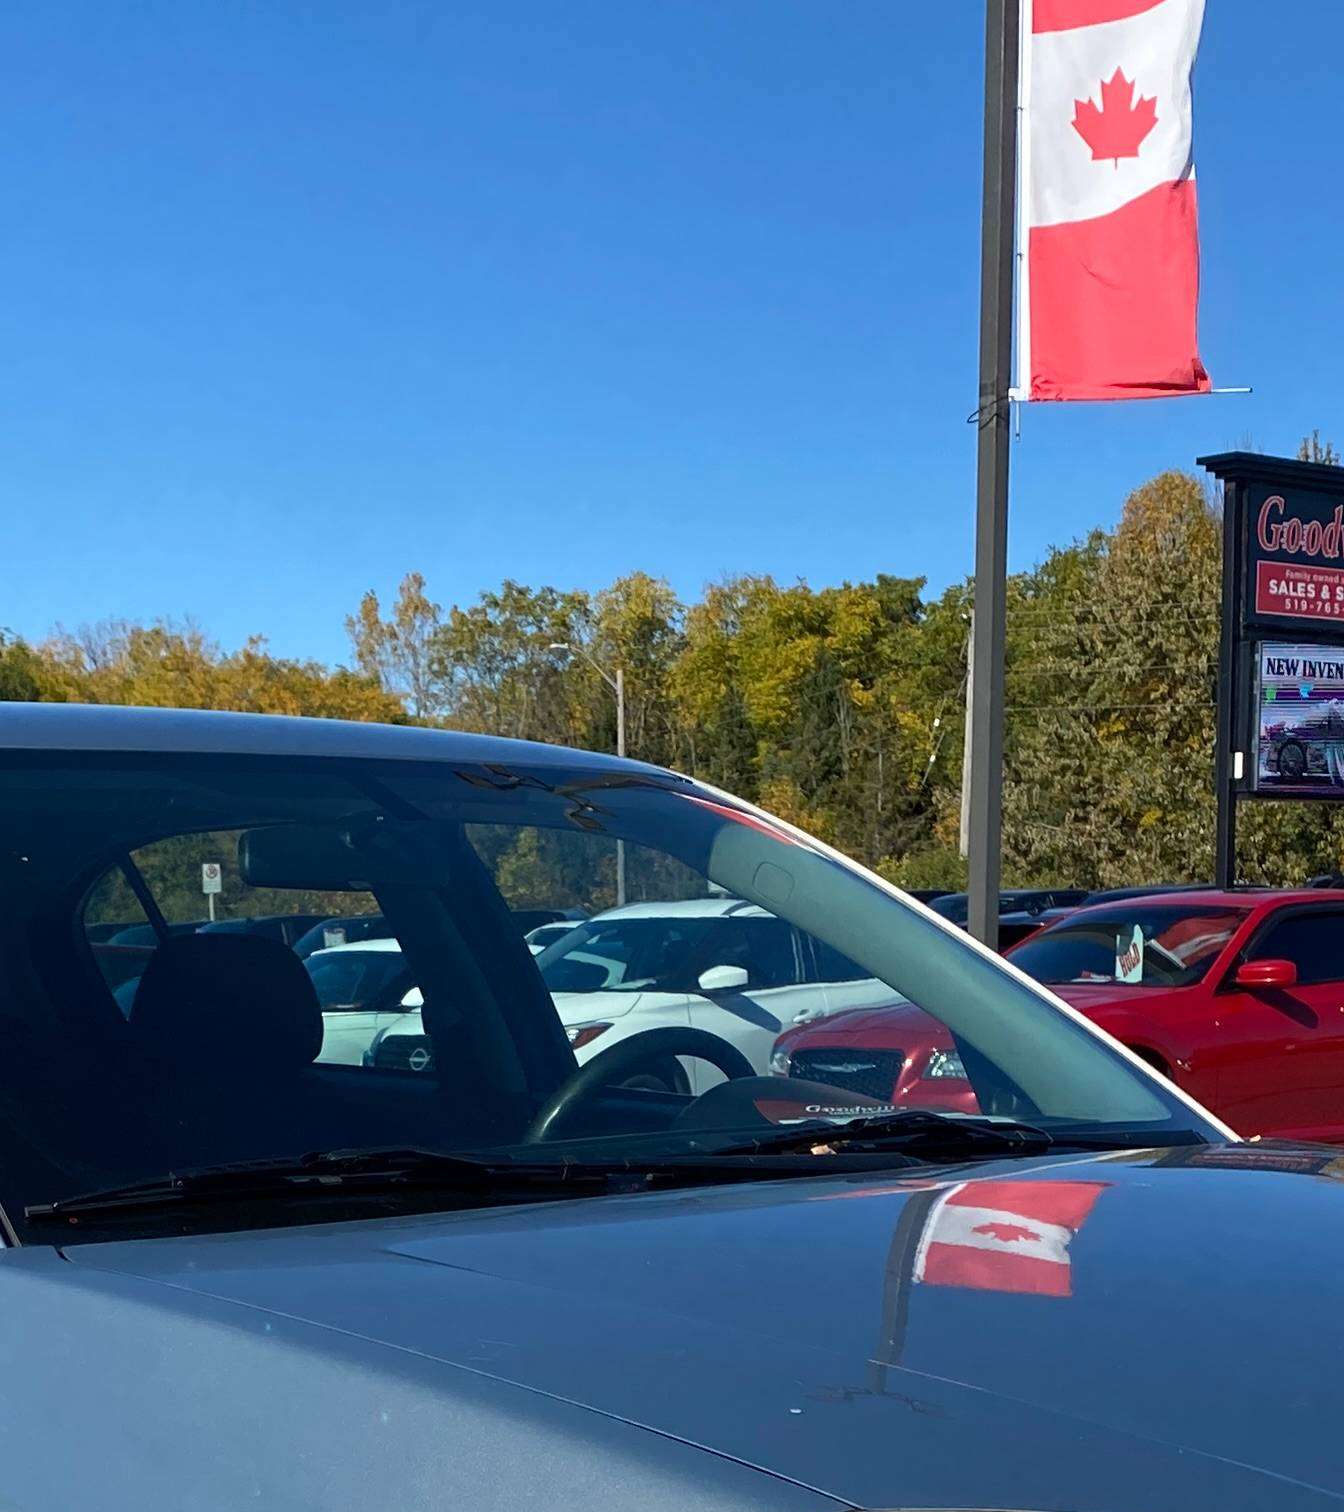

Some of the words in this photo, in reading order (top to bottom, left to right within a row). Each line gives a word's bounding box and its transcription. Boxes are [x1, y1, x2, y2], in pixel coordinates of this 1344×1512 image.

[1285, 569, 1311, 581] Family
[1313, 573, 1339, 585] owned
[1268, 579, 1316, 598] SALES
[1321, 586, 1330, 600] &
[1266, 657, 1299, 677] NEW
[1119, 942, 1141, 978] HOLD
